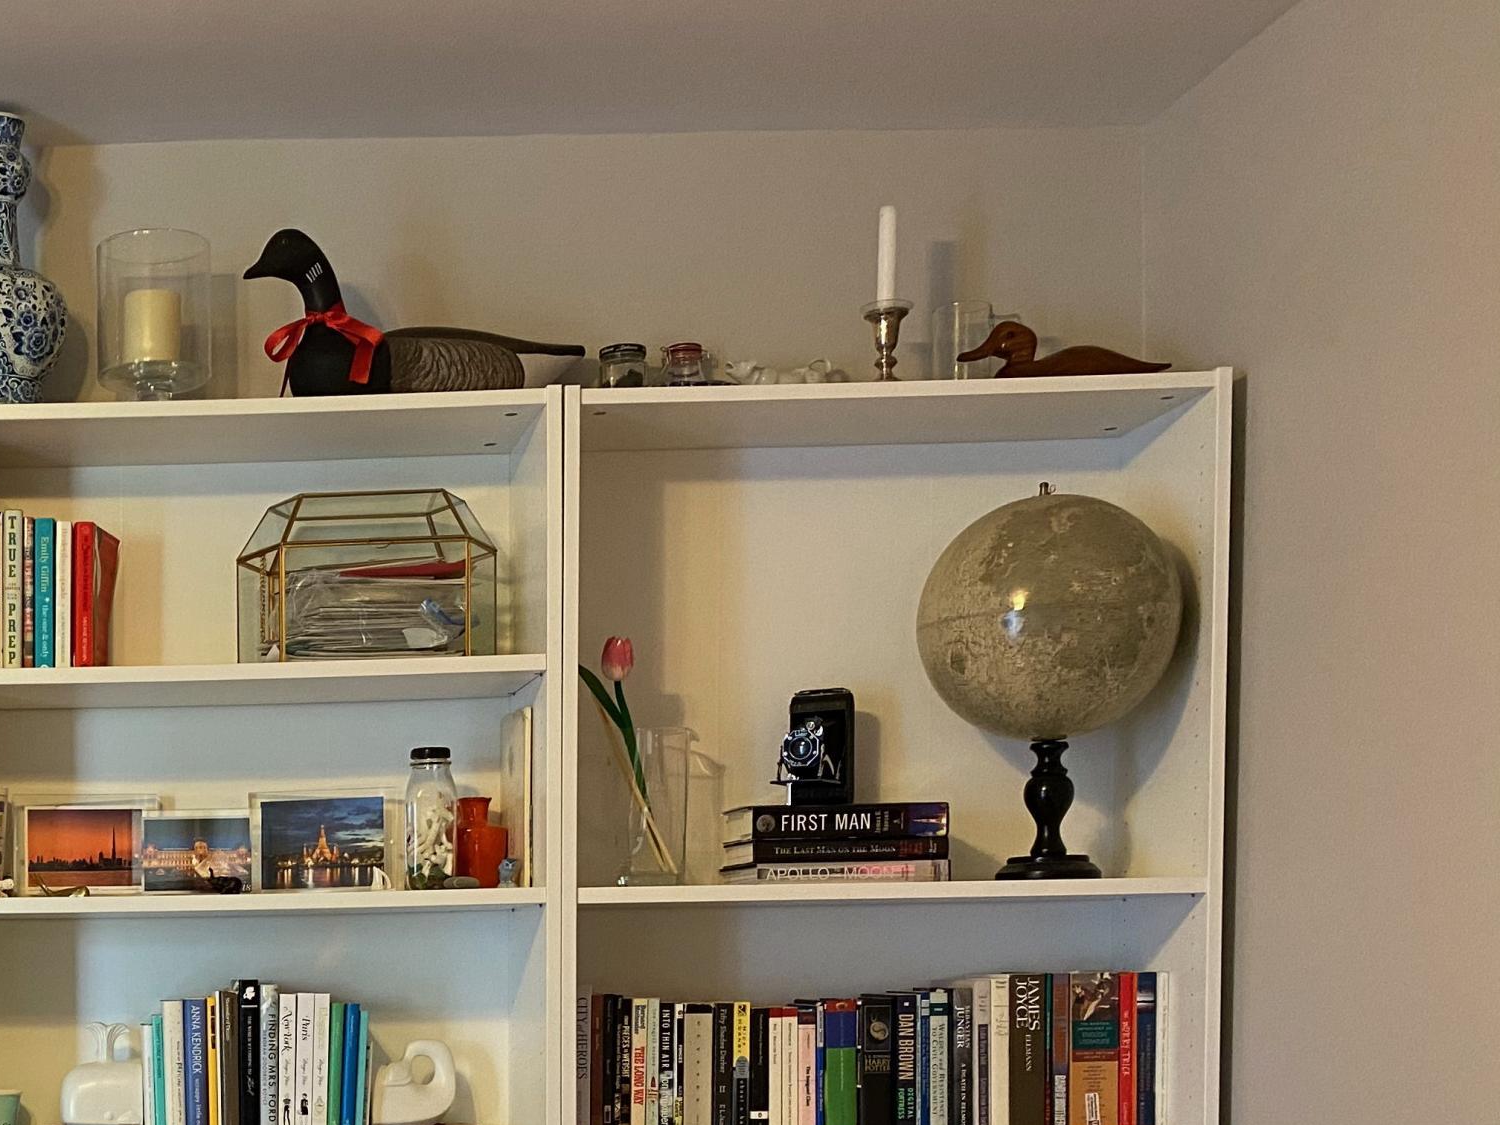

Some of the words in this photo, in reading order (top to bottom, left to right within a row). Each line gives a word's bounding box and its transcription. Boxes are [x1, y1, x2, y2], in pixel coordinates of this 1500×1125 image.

[7, 516, 17, 578] TRUE
[40, 536, 51, 562] Emily
[40, 565, 51, 593] Giffin
[7, 603, 17, 665] PREP
[780, 813, 828, 832] FIRST
[834, 813, 871, 832] MAN
[577, 997, 588, 1022] CITY
[1016, 978, 1028, 1029] JOYCE
[1027, 977, 1040, 1031] JAMES
[191, 1005, 202, 1030] ANNA
[301, 1018, 311, 1041] Paris
[662, 1009, 670, 1029] INTO
[898, 1014, 914, 1037] DAN
[957, 1005, 965, 1049] JUNGER
[268, 1014, 276, 1060] FINDING
[662, 1031, 670, 1050] THIN
[191, 1032, 202, 1074] KENDRICK
[577, 1033, 588, 1079] HEROES
[634, 1047, 645, 1064] THE
[662, 1053, 670, 1068] AIR
[898, 1039, 914, 1080] BROWN
[268, 1064, 276, 1088] MRS.
[634, 1066, 645, 1087] LONG
[194, 1078, 202, 1103] scrappy
[634, 1088, 645, 1106] WAY
[194, 1104, 202, 1119] little
[268, 1093, 276, 1122] FORD
